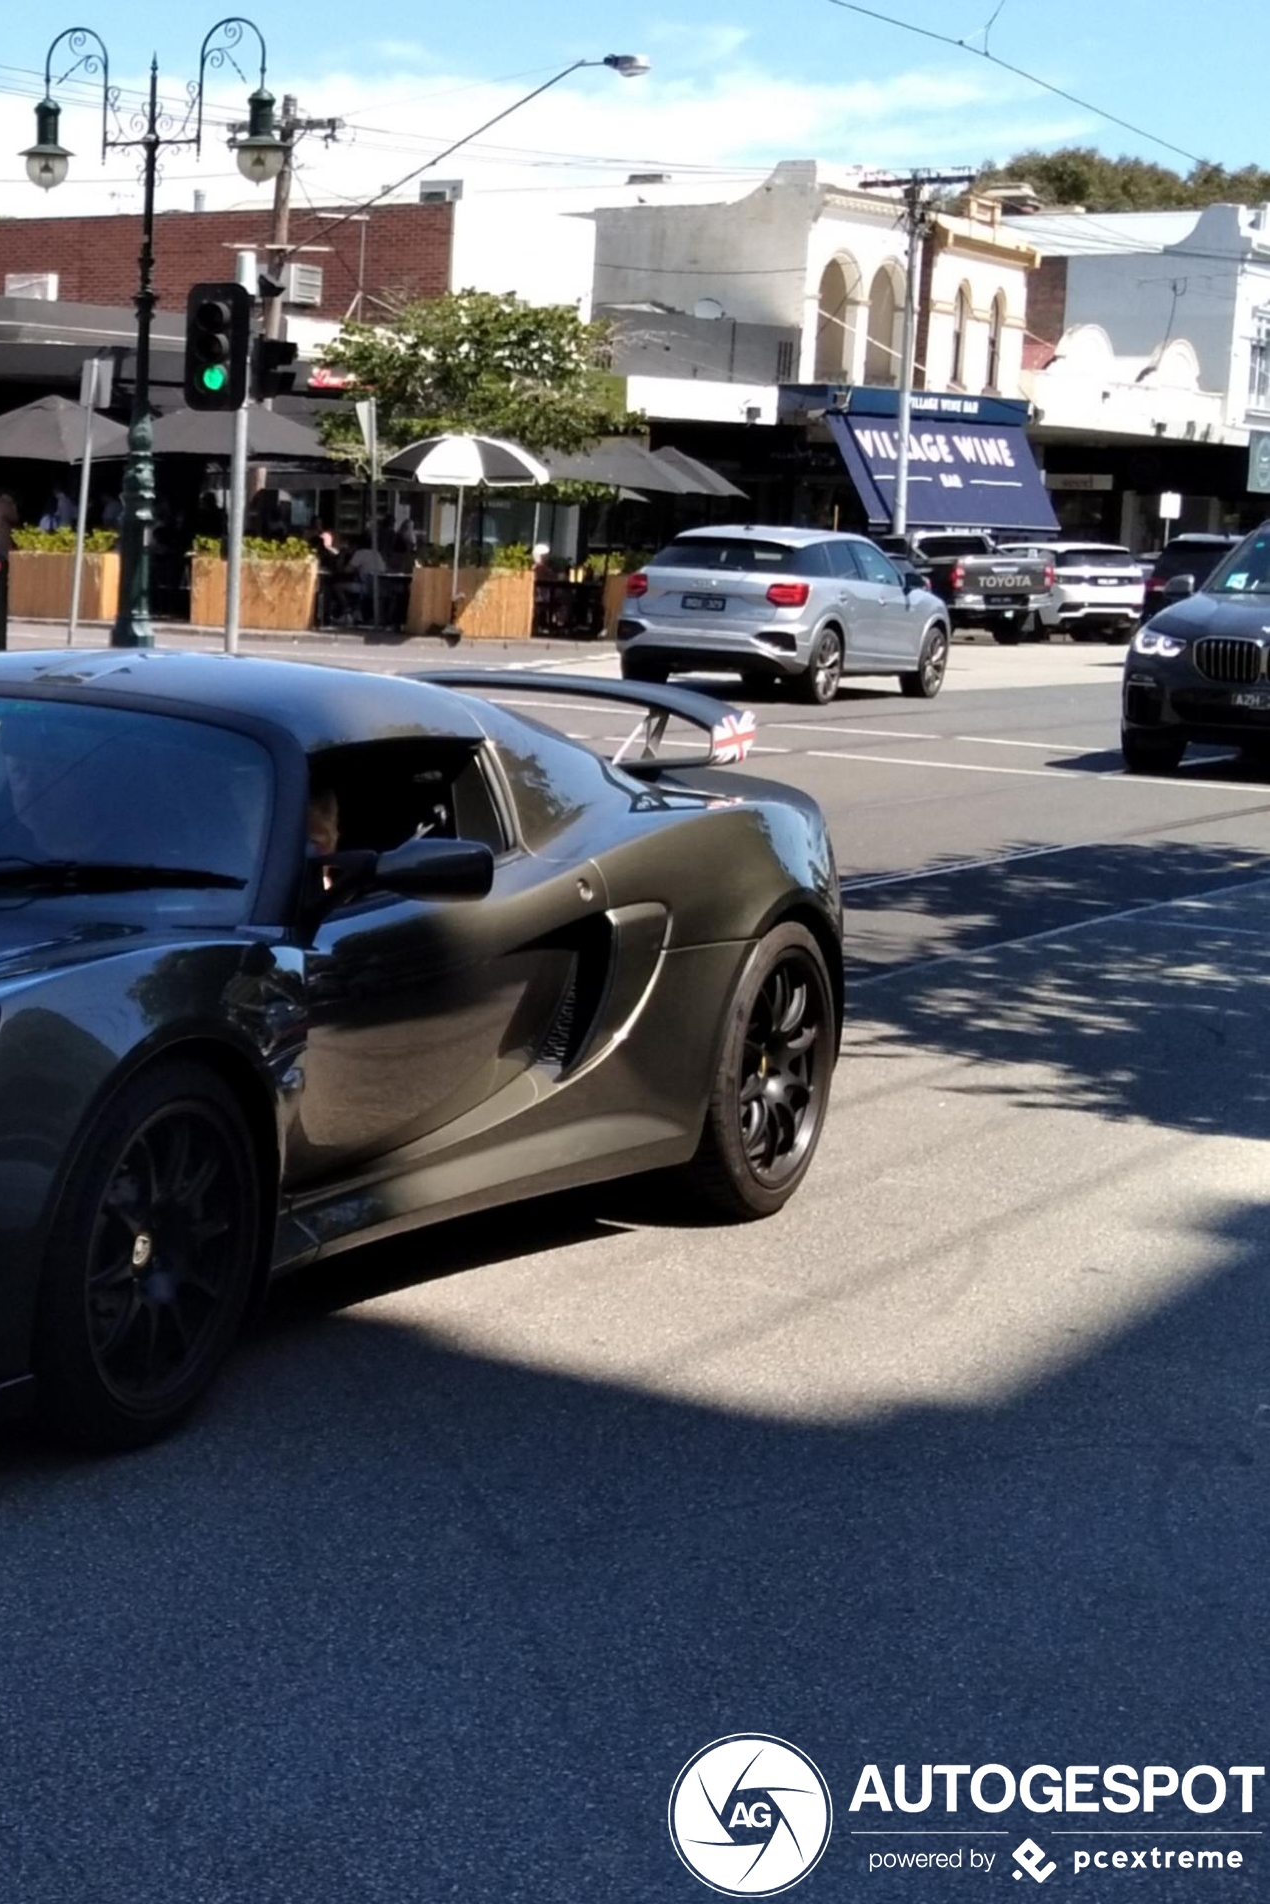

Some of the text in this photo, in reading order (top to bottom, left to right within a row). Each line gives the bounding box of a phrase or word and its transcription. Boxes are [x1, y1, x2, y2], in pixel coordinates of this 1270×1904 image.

[940, 399, 963, 414] WINE
[963, 401, 979, 415] BAR
[951, 434, 1016, 468] WINE
[939, 473, 964, 489] BAR
[978, 575, 1032, 588] TOYOTA
